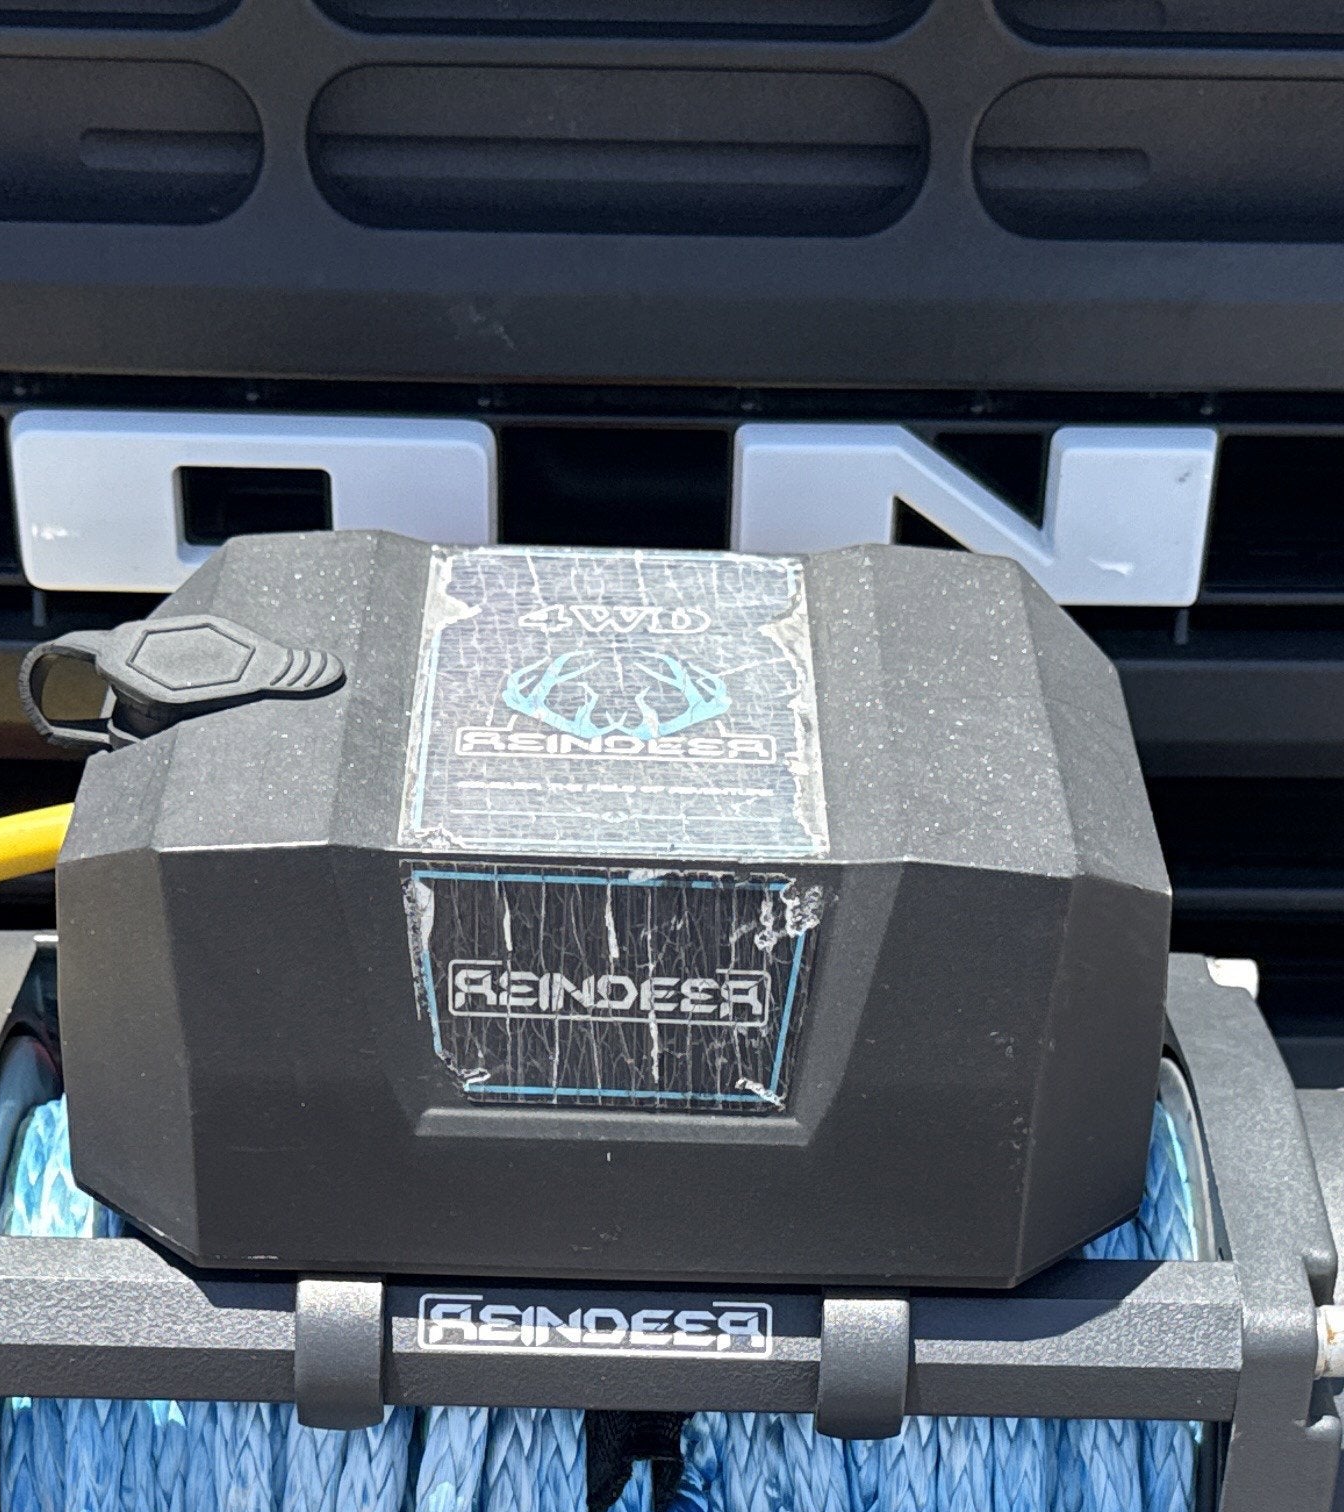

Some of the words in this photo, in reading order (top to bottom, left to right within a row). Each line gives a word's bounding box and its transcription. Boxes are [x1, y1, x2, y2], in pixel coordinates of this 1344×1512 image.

[518, 604, 712, 633] 4WD
[460, 732, 770, 759] REINDEER
[453, 969, 763, 1018] REINDEER
[428, 1302, 765, 1352] REINDEER
